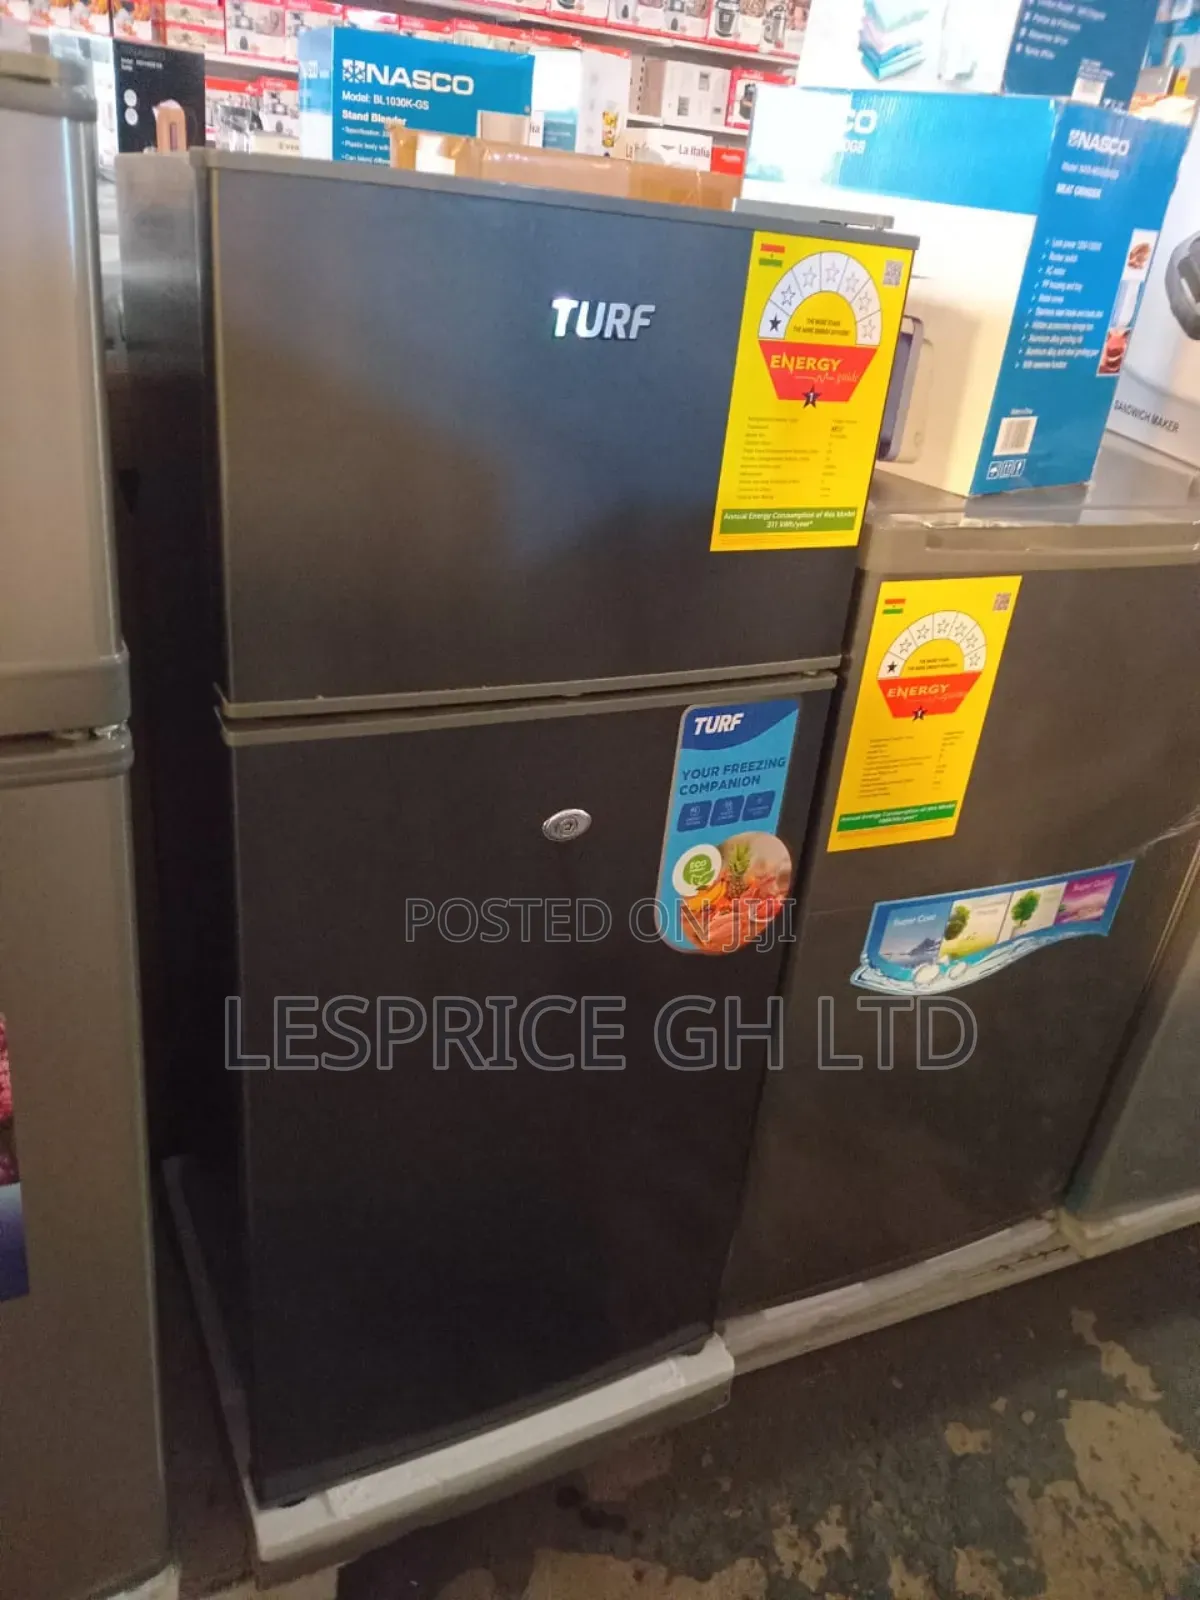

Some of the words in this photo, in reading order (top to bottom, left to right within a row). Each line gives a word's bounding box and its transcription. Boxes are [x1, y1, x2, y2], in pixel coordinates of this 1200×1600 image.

[366, 63, 475, 96] NASCO
[342, 90, 371, 104] Model:
[342, 109, 369, 123] Stand
[678, 144, 689, 155] La
[551, 298, 656, 340] TURF
[770, 352, 841, 375] ENERGY
[748, 511, 771, 521] Energy
[887, 683, 949, 700] ENERGY
[694, 712, 744, 736] TURF
[682, 765, 720, 781] YOUR
[724, 756, 786, 775] FREEZING
[680, 774, 761, 796] COMPANION
